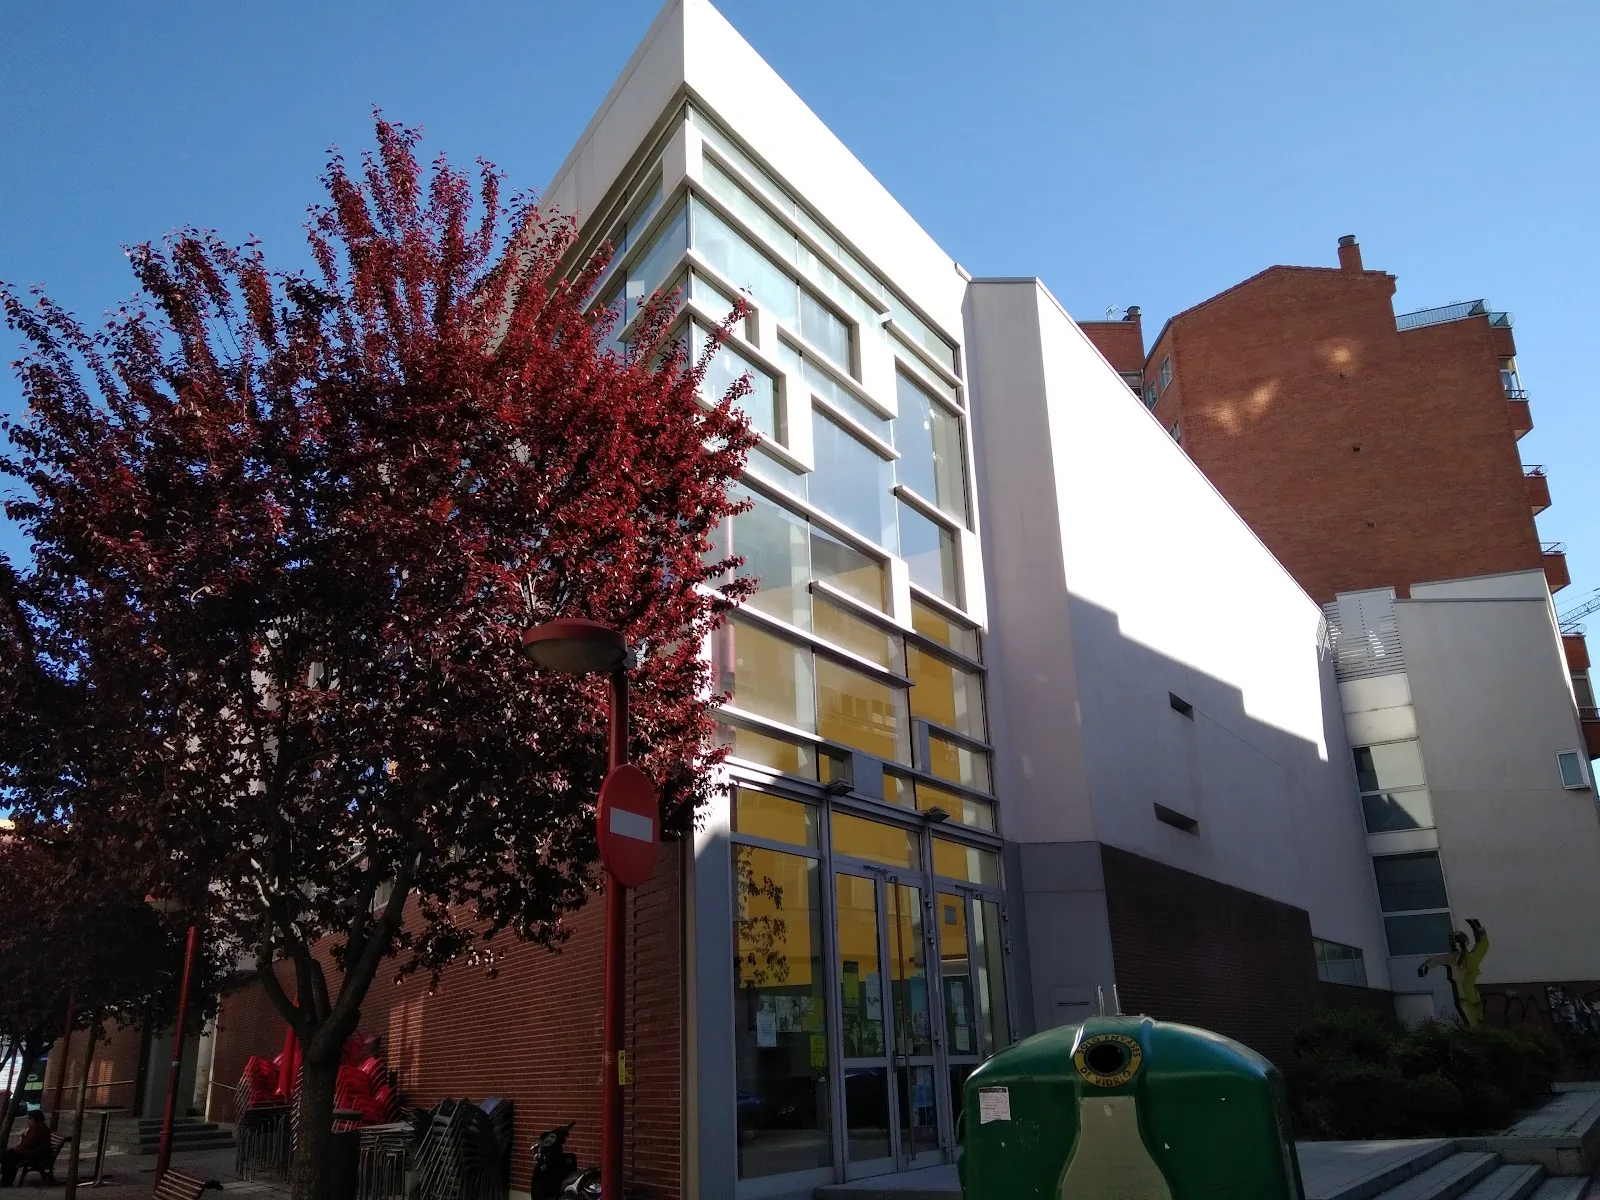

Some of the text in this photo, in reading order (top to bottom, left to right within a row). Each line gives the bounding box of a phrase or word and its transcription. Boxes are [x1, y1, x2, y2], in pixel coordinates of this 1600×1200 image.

[1077, 1036, 1141, 1057] SOLO ENVASES
[1080, 1067, 1131, 1086] DE VIDRIO
